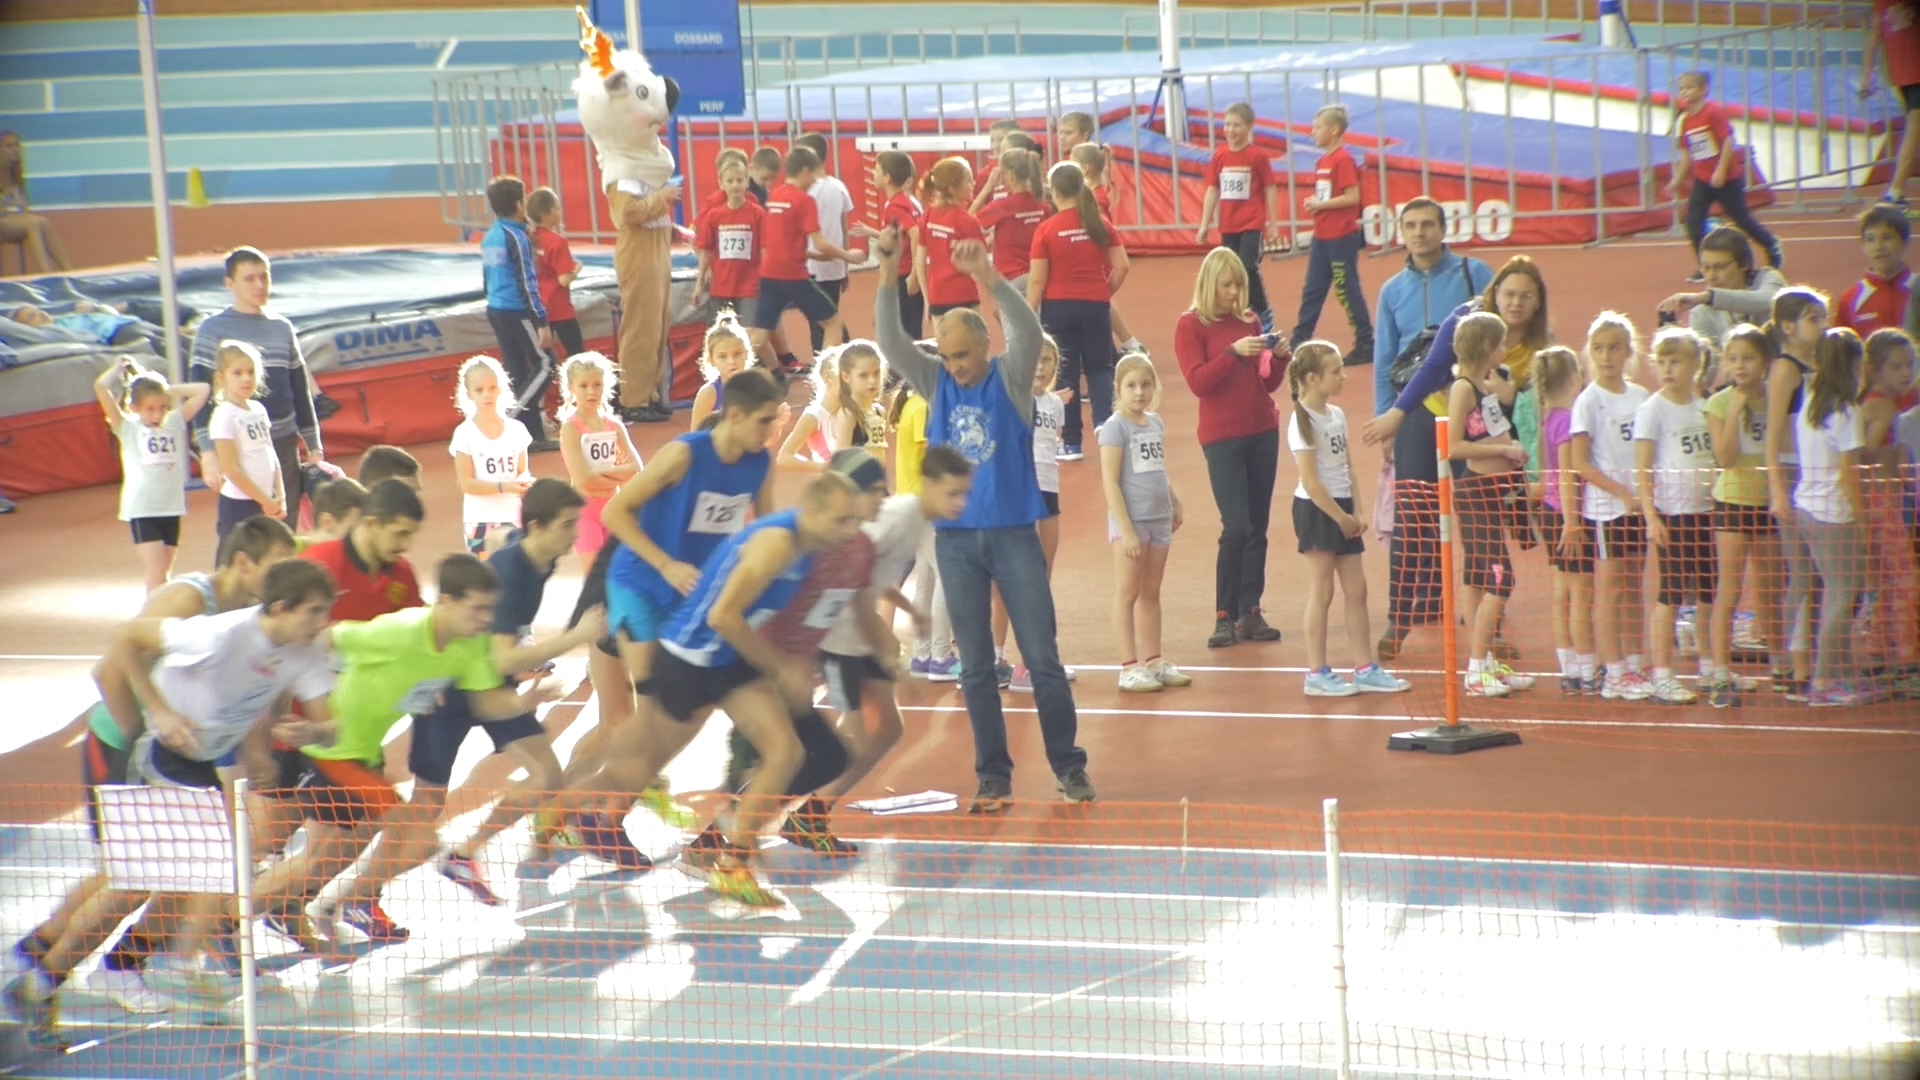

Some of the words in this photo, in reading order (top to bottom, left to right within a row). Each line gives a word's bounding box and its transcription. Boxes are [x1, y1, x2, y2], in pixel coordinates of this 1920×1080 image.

[674, 32, 723, 45] DOSSARD
[699, 101, 725, 113] PERF
[1223, 179, 1244, 193] 288
[722, 237, 746, 252] 273
[334, 319, 443, 352] DIMA
[1034, 411, 1057, 430] 566
[149, 436, 177, 453] 621
[1140, 441, 1164, 461] 565
[1681, 432, 1711, 455] 518
[486, 456, 515, 475] 615
